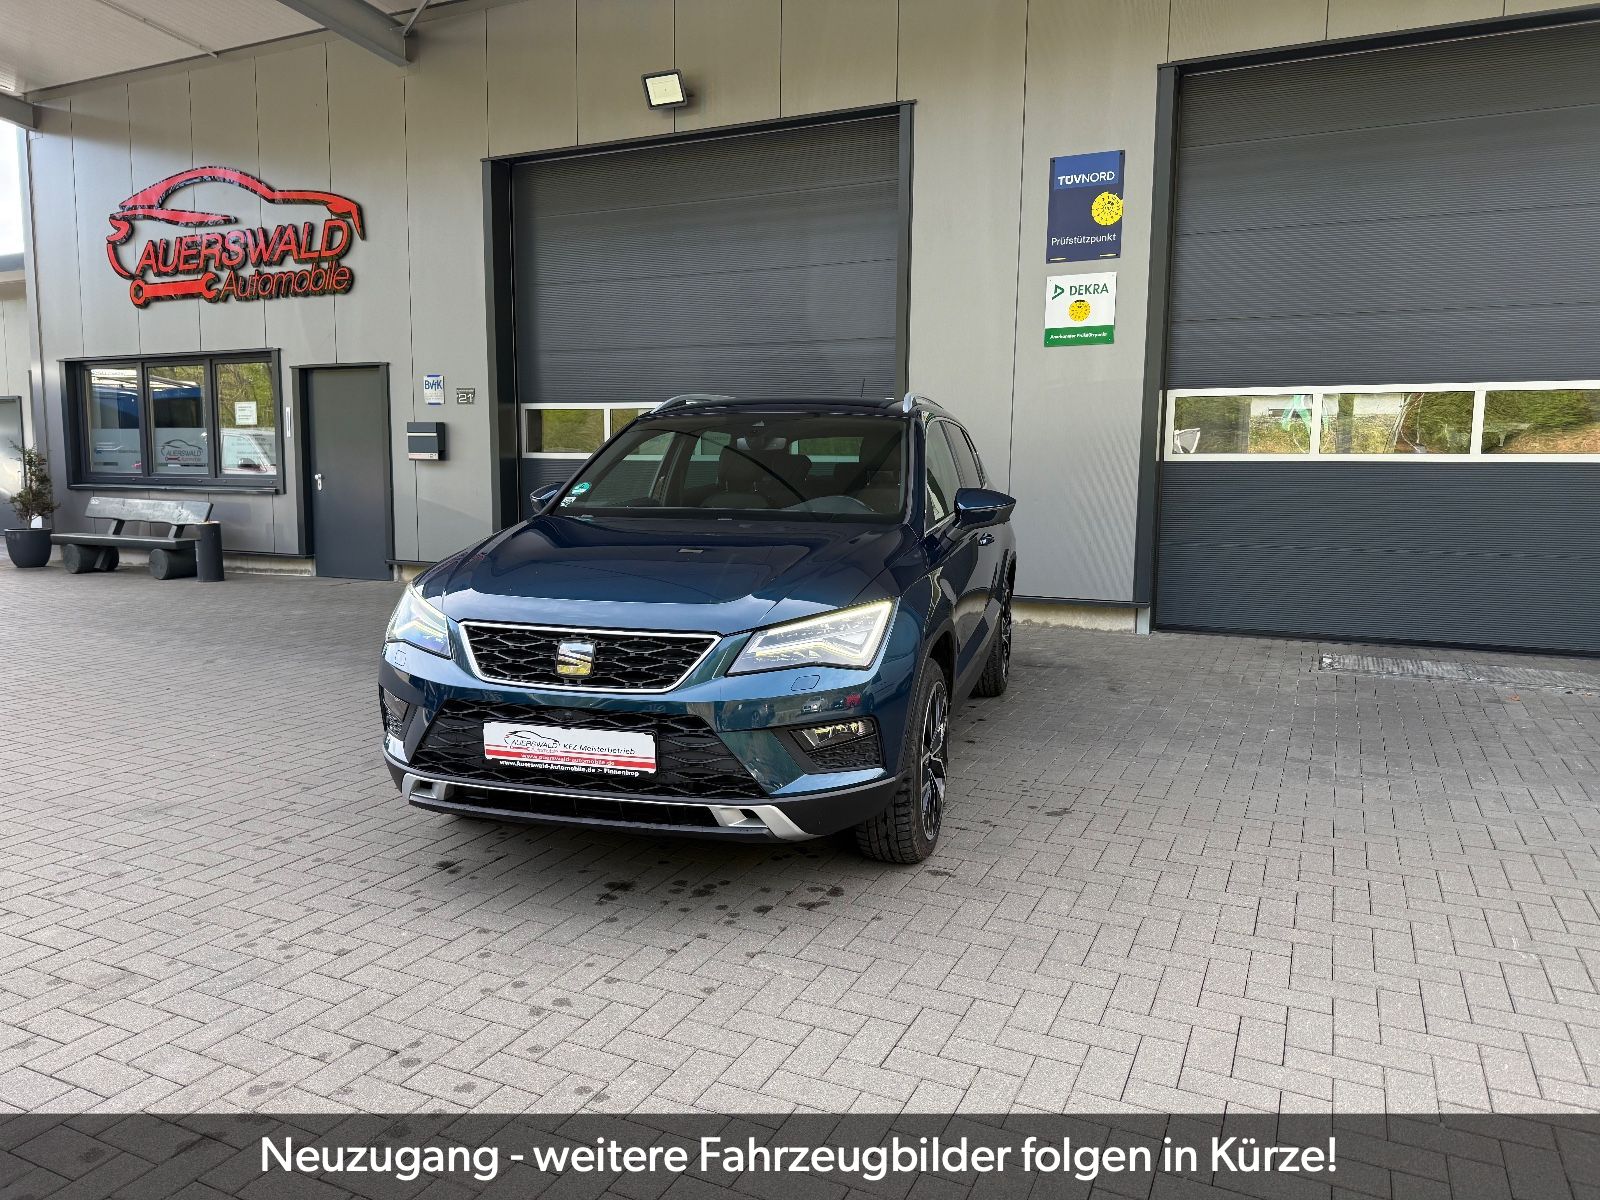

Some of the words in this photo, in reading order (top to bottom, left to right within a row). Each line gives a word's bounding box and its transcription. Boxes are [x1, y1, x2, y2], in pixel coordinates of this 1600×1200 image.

[134, 217, 352, 278] AUERSWALD
[1051, 232, 1117, 246] Prüfstützpunkt
[218, 261, 354, 299] Automobile
[1069, 283, 1109, 296] DEKRA
